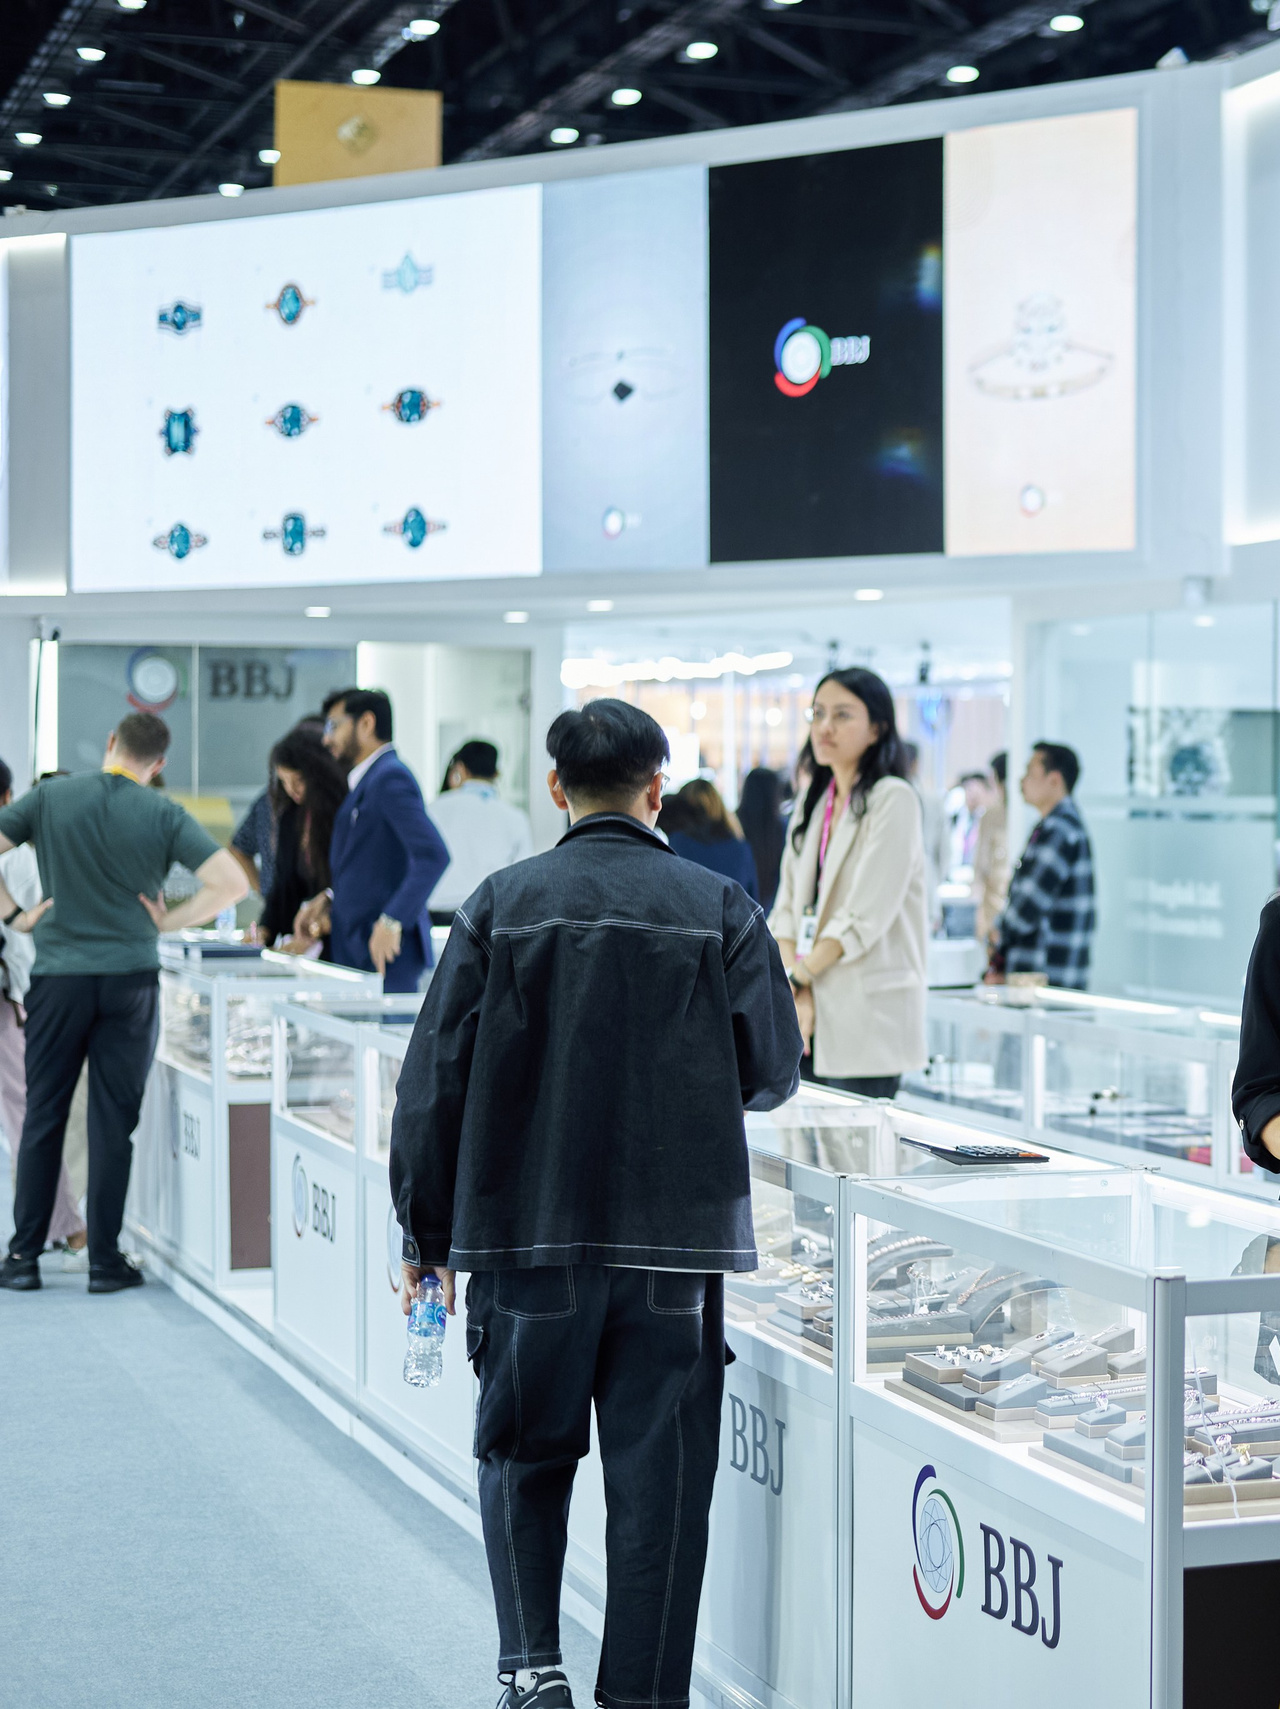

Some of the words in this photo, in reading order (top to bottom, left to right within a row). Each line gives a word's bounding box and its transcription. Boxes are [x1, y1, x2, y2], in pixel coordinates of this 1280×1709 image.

[207, 659, 296, 701] BBJ
[312, 1181, 336, 1243] BBJ
[728, 1392, 787, 1497] BBJ
[979, 1521, 1064, 1650] BBJ
